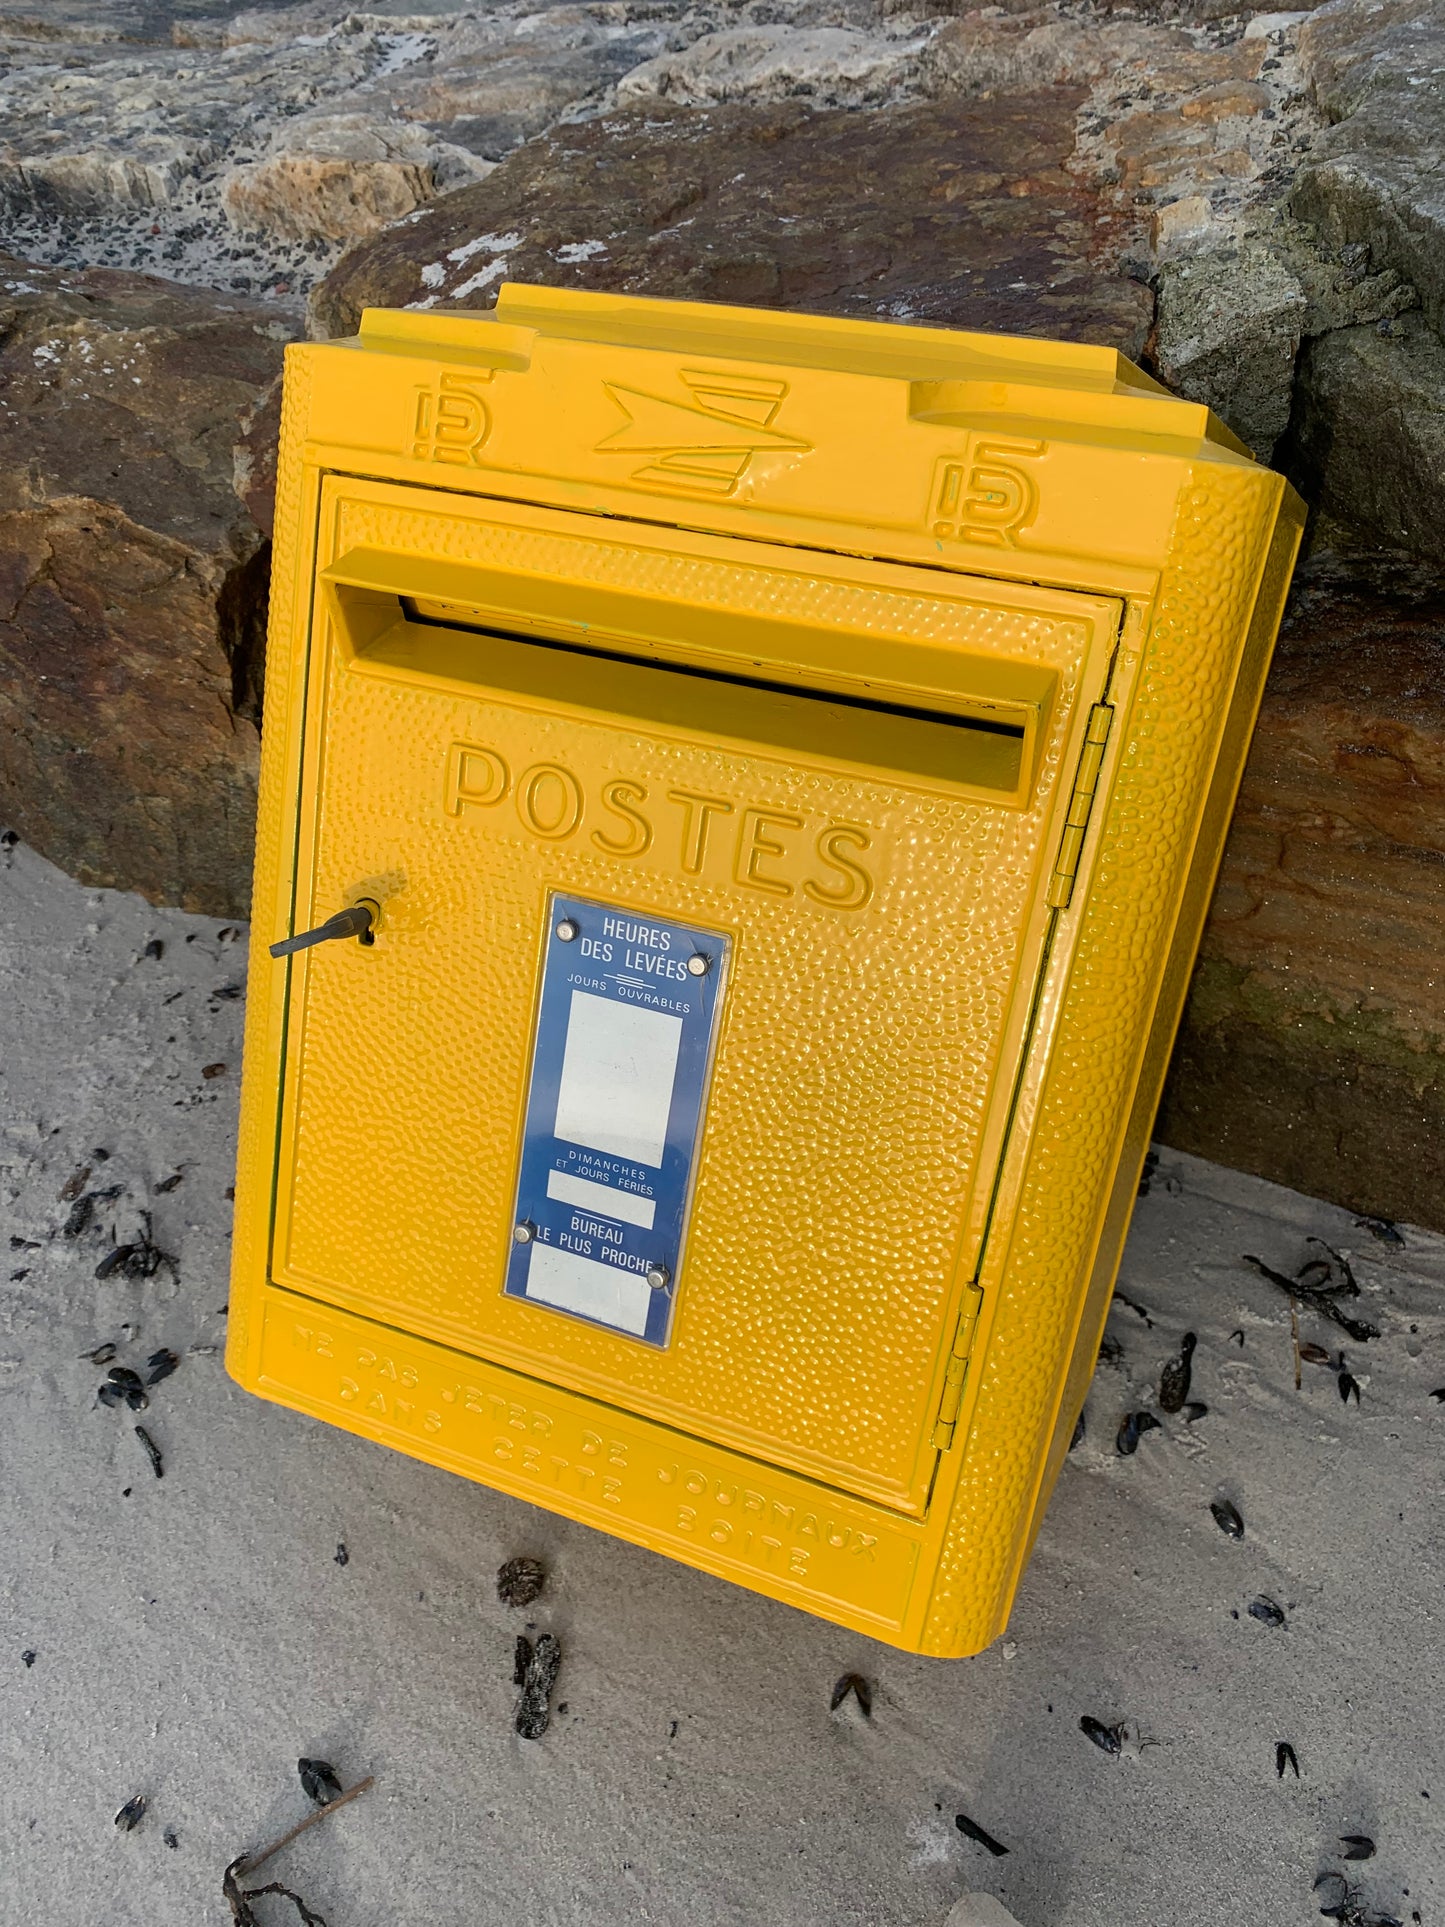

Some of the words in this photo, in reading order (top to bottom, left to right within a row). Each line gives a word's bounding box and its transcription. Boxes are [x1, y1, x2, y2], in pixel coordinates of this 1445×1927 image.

[443, 742, 874, 911] POSTES
[603, 917, 671, 951] HEURES
[580, 937, 613, 963] DES
[625, 949, 687, 982] LEVÉES
[567, 973, 607, 991] JOURS
[618, 987, 690, 1014] OUVRABLES
[556, 1159, 568, 1168] ET
[575, 1165, 610, 1182] JOURS
[618, 1177, 654, 1196] FÉRIÉS
[569, 1150, 646, 1180] DIMANCHES
[536, 1225, 551, 1241] LE
[559, 1232, 592, 1254] PLUS
[601, 1246, 654, 1274] PROCHE
[571, 1216, 624, 1245] BUREAU
[293, 1323, 333, 1358] NE
[355, 1347, 419, 1388] PAS
[441, 1384, 553, 1439] JETER
[581, 1429, 628, 1468] DE
[656, 1464, 878, 1562] JOURNAUX
[340, 1376, 441, 1433] DANS
[494, 1436, 622, 1504] CETTE
[676, 1505, 811, 1576] BOITE
